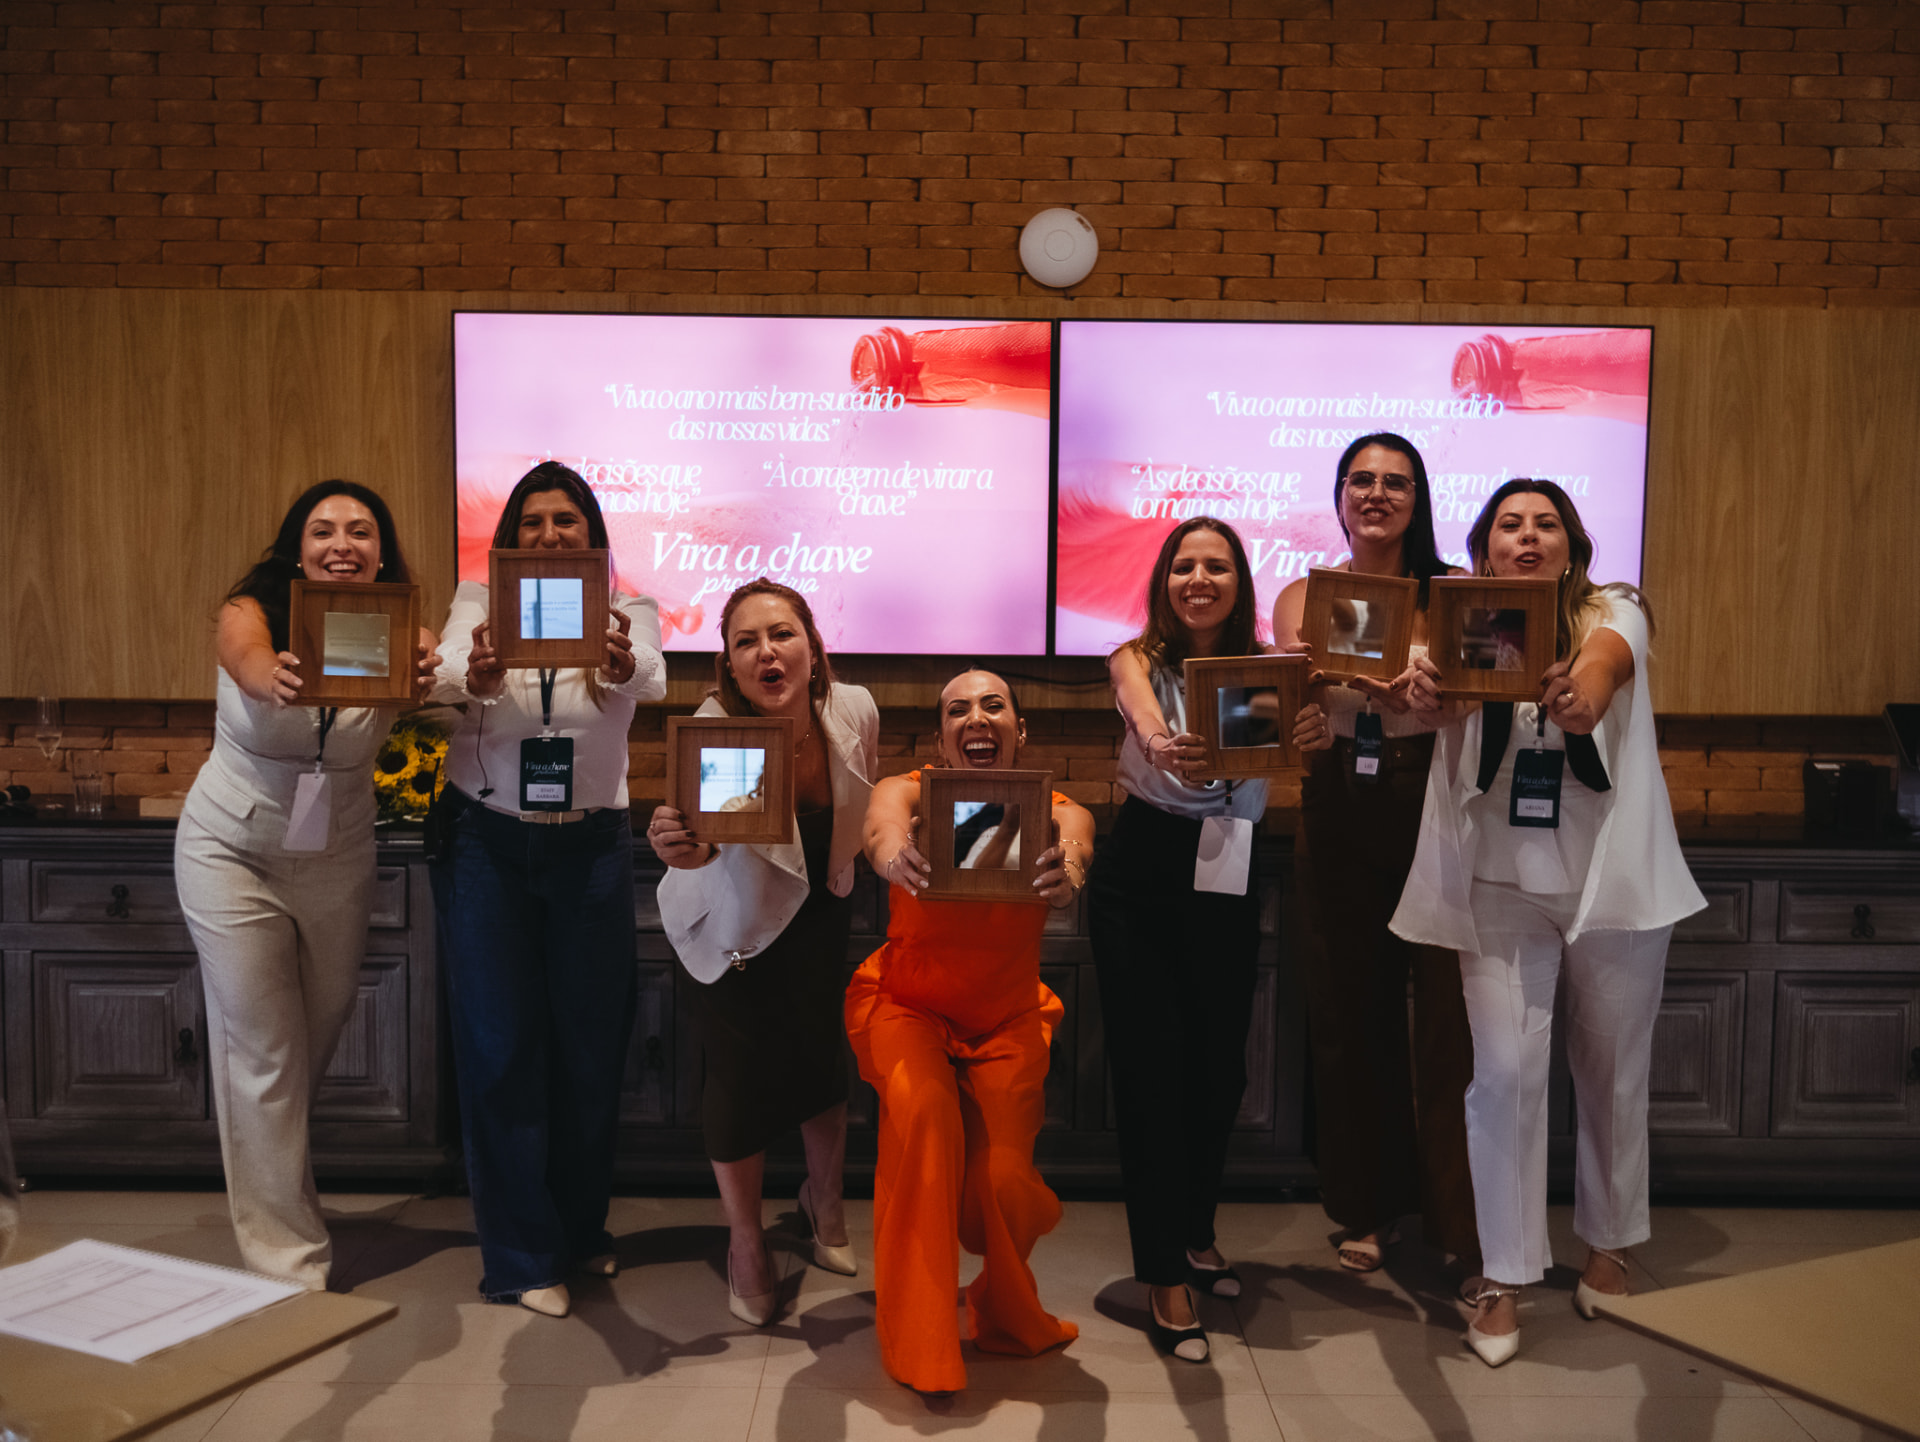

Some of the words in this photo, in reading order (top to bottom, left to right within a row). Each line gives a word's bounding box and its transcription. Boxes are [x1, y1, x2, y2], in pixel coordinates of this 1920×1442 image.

[658, 390, 673, 409] o
[675, 390, 715, 410] ano
[717, 385, 768, 411] mais
[770, 385, 904, 412] bem-sucedido
[1258, 397, 1274, 416] o
[1275, 397, 1316, 417] ano
[1318, 392, 1368, 418] mais
[1369, 392, 1504, 419] bem-sucedido
[668, 415, 705, 440] das
[708, 421, 775, 441] nossas
[1269, 422, 1305, 448] das
[660, 464, 702, 495] que
[790, 466, 890, 496] coragem
[892, 460, 920, 489] de
[921, 462, 977, 489] virar
[976, 468, 994, 490] a
[1169, 464, 1259, 492] decisões
[1259, 471, 1301, 502] que
[1131, 494, 1239, 519] tomamos
[651, 532, 729, 572] Vira
[734, 545, 760, 572] a
[768, 532, 873, 574] chave
[1250, 538, 1325, 578] Vira
